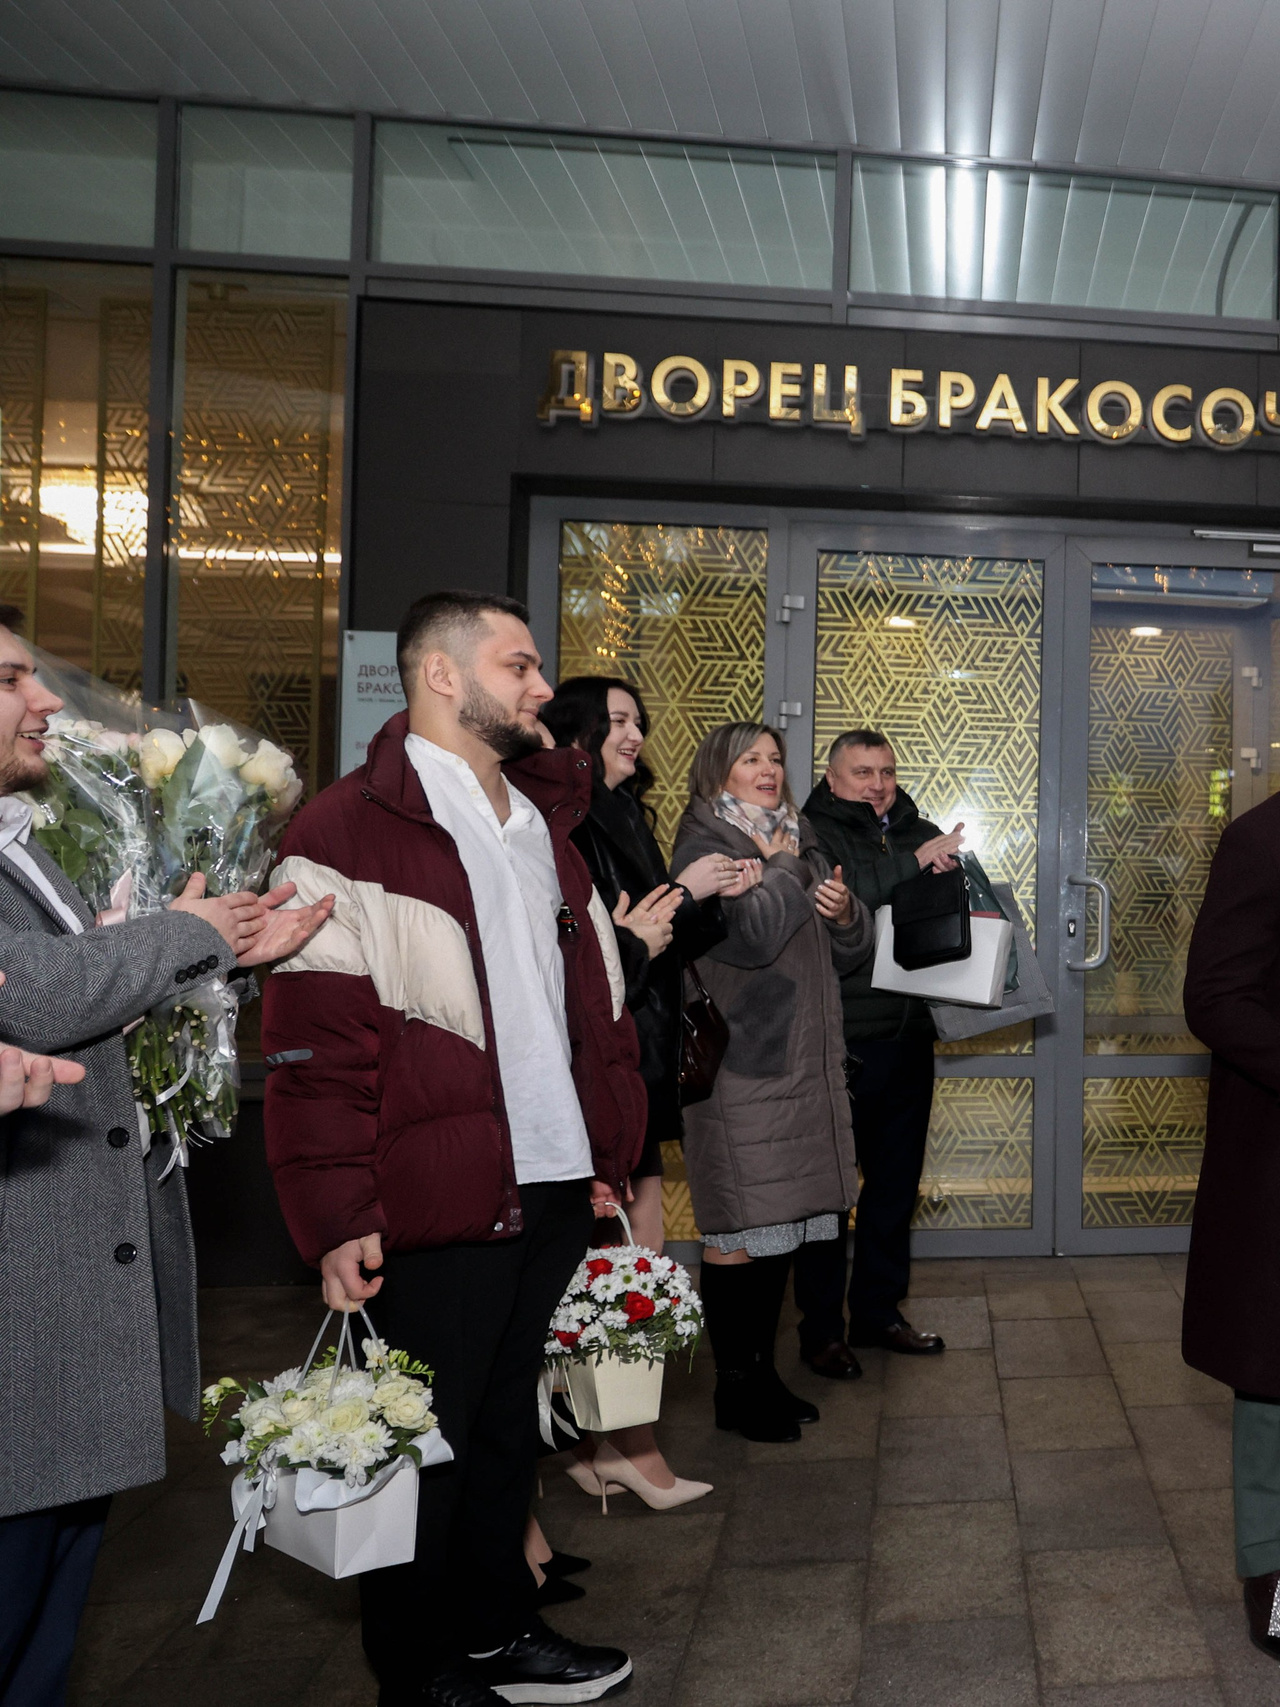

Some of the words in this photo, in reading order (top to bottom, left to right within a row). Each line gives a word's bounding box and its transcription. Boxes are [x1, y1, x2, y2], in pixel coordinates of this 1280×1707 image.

[536, 349, 863, 436] ДВОРЕЦ
[357, 664, 397, 677] ДВОР
[357, 682, 402, 694] БРАКО
